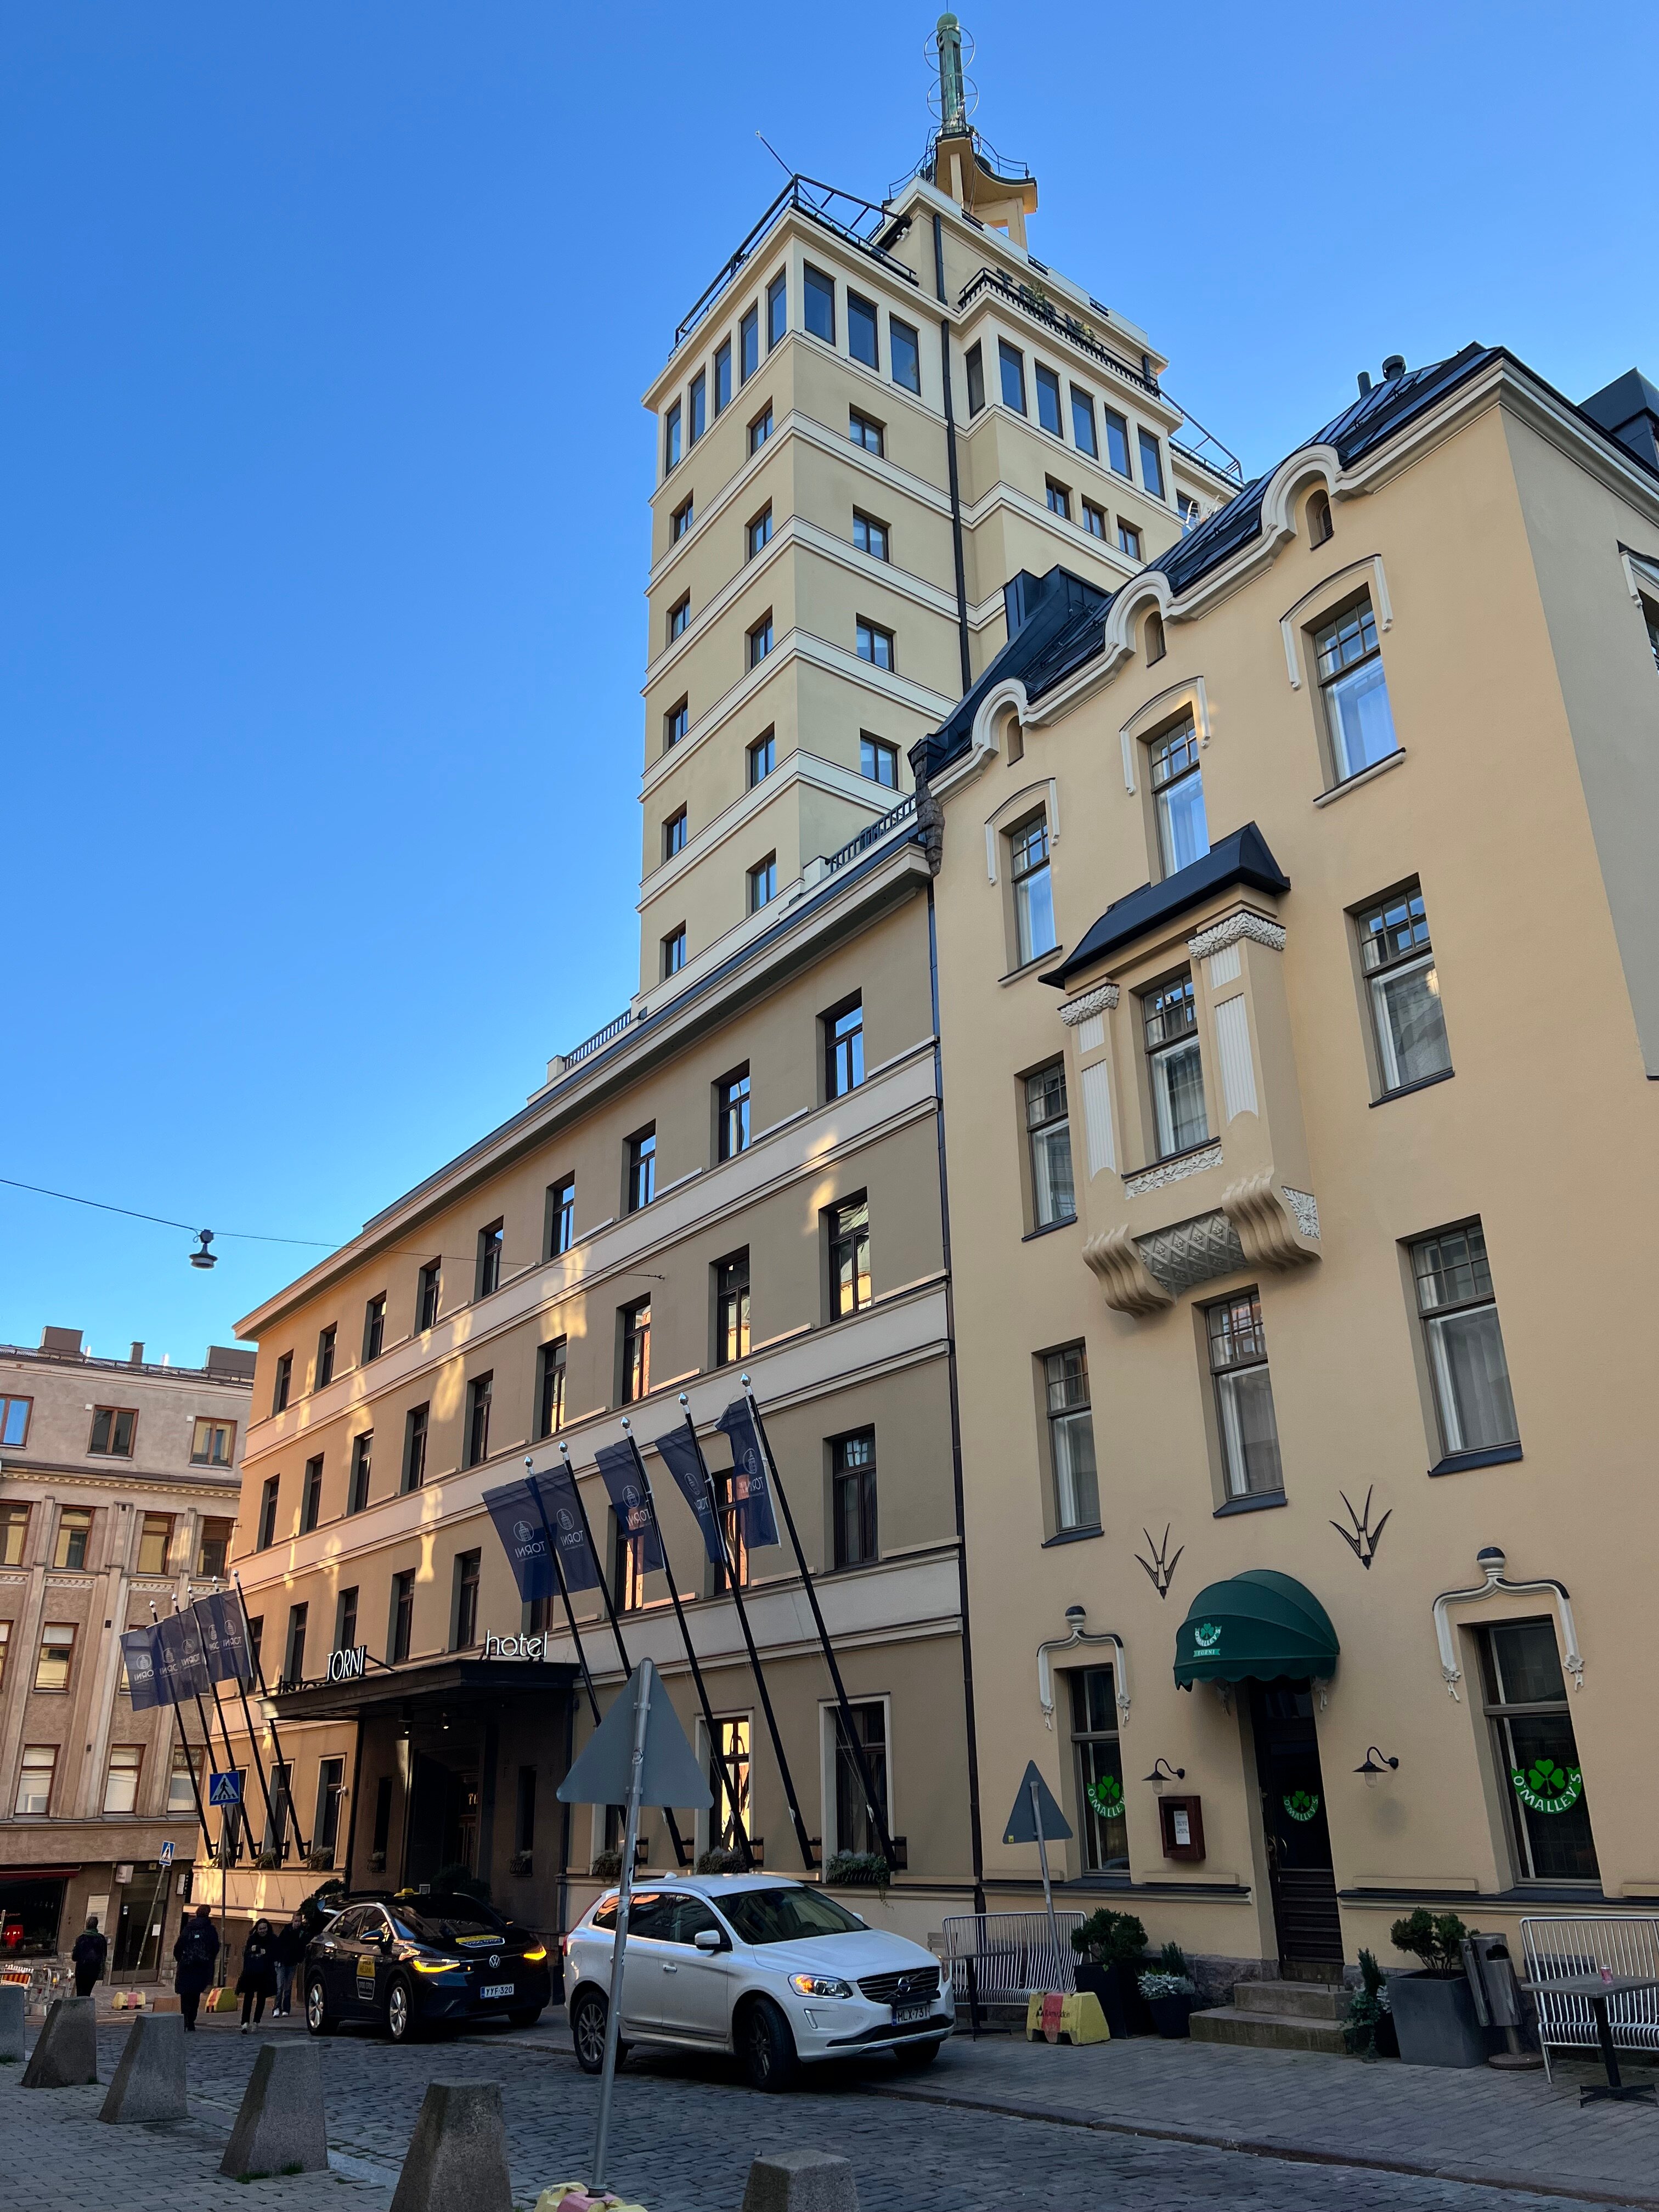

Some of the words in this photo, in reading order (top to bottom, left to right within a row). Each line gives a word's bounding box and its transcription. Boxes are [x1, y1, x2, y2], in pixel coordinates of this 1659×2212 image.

[486, 1629, 548, 1657] hotel
[326, 1645, 364, 1682] TORNI
[1513, 1773, 1582, 1813] O'MALLEY'S
[1284, 1799, 1318, 1821] O'MALLEY'S
[486, 1986, 513, 1996] YYF-320
[897, 2006, 928, 2022] MLX-731
